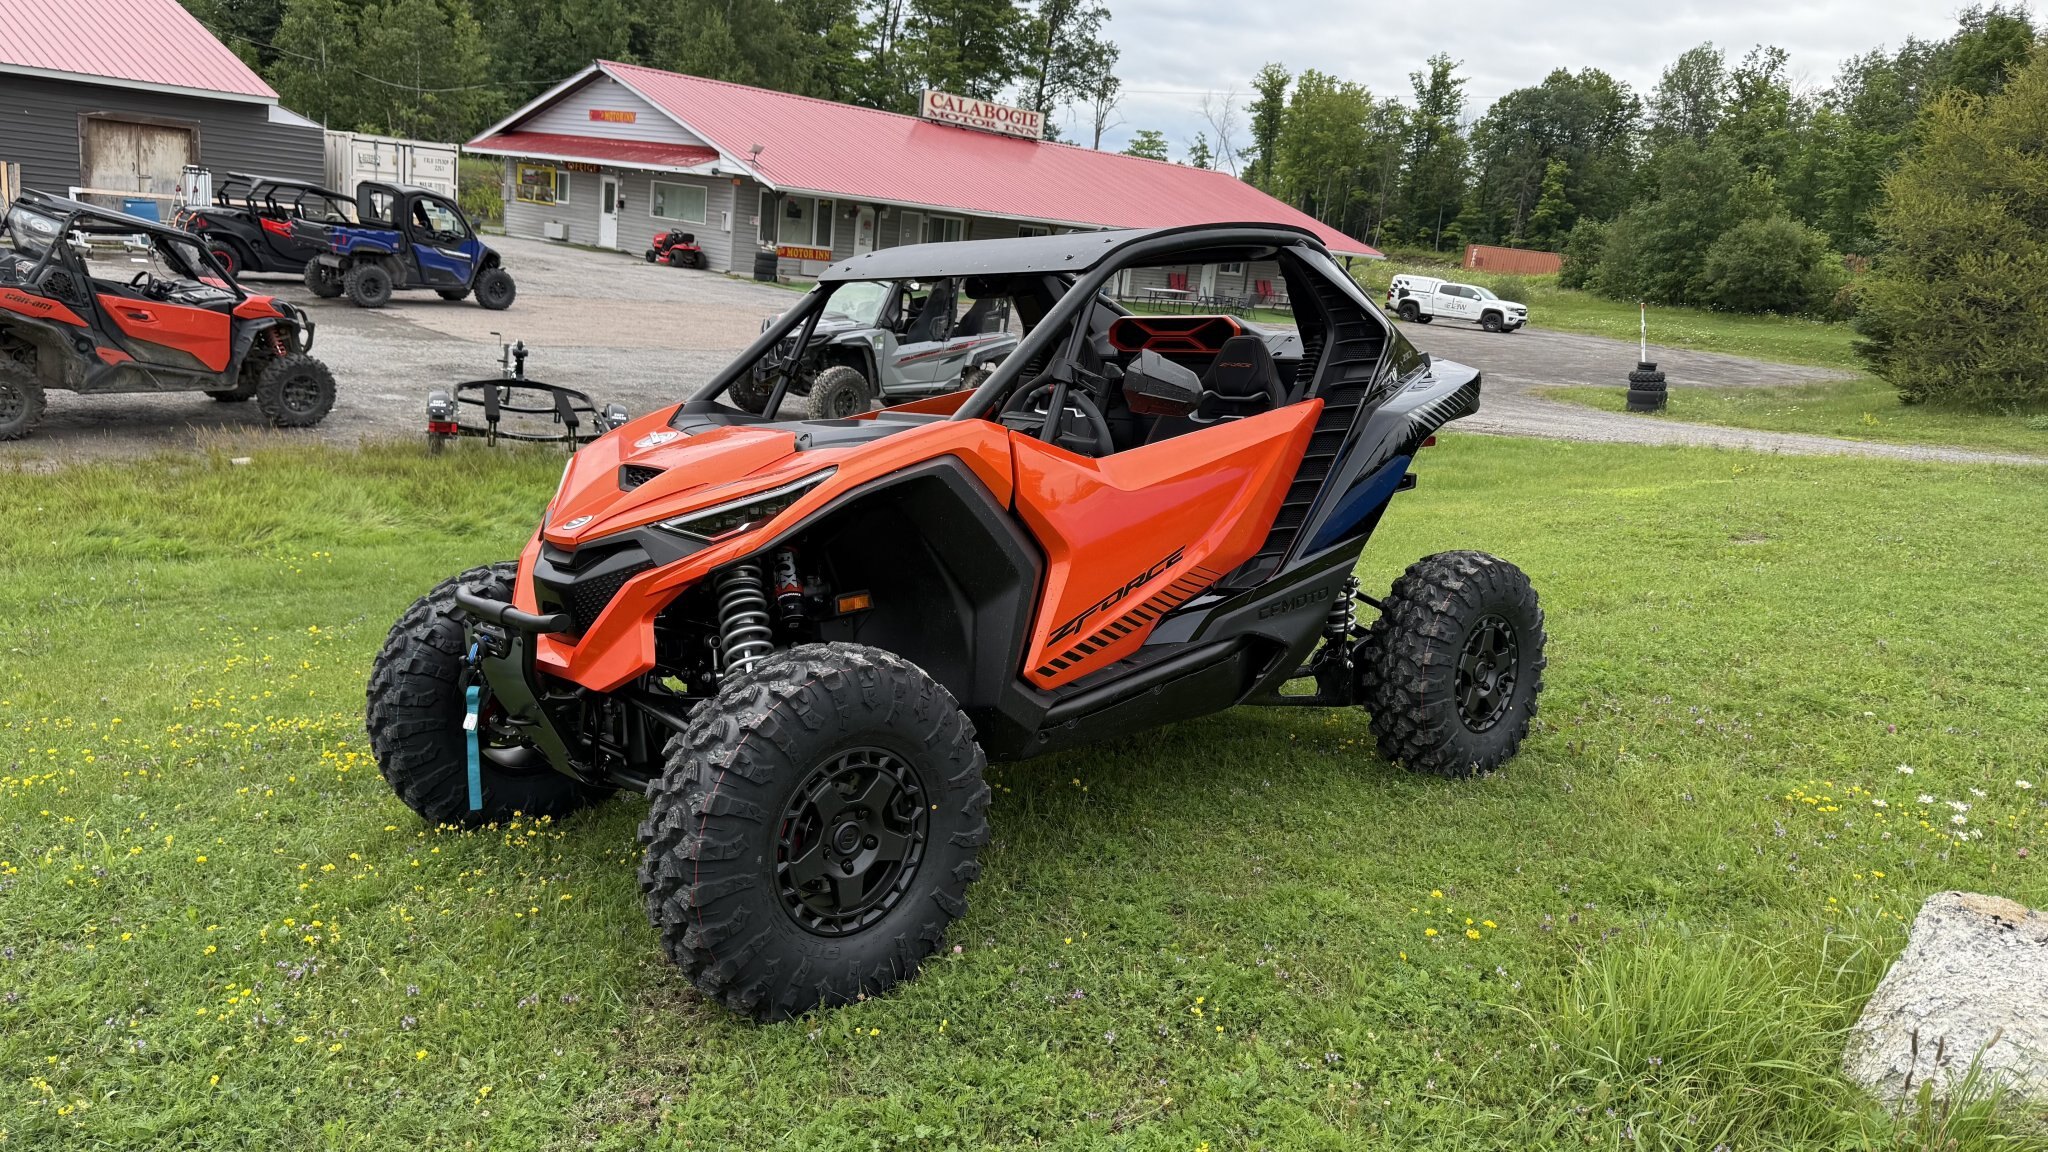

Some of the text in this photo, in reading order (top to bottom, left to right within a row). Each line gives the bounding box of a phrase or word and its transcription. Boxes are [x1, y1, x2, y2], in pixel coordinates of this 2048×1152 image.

[928, 109, 1038, 137] MOTOR INN
[930, 92, 1039, 128] CALABOGIE
[786, 247, 814, 259] MOTOR
[815, 250, 830, 260] INN
[775, 552, 798, 589] FOX
